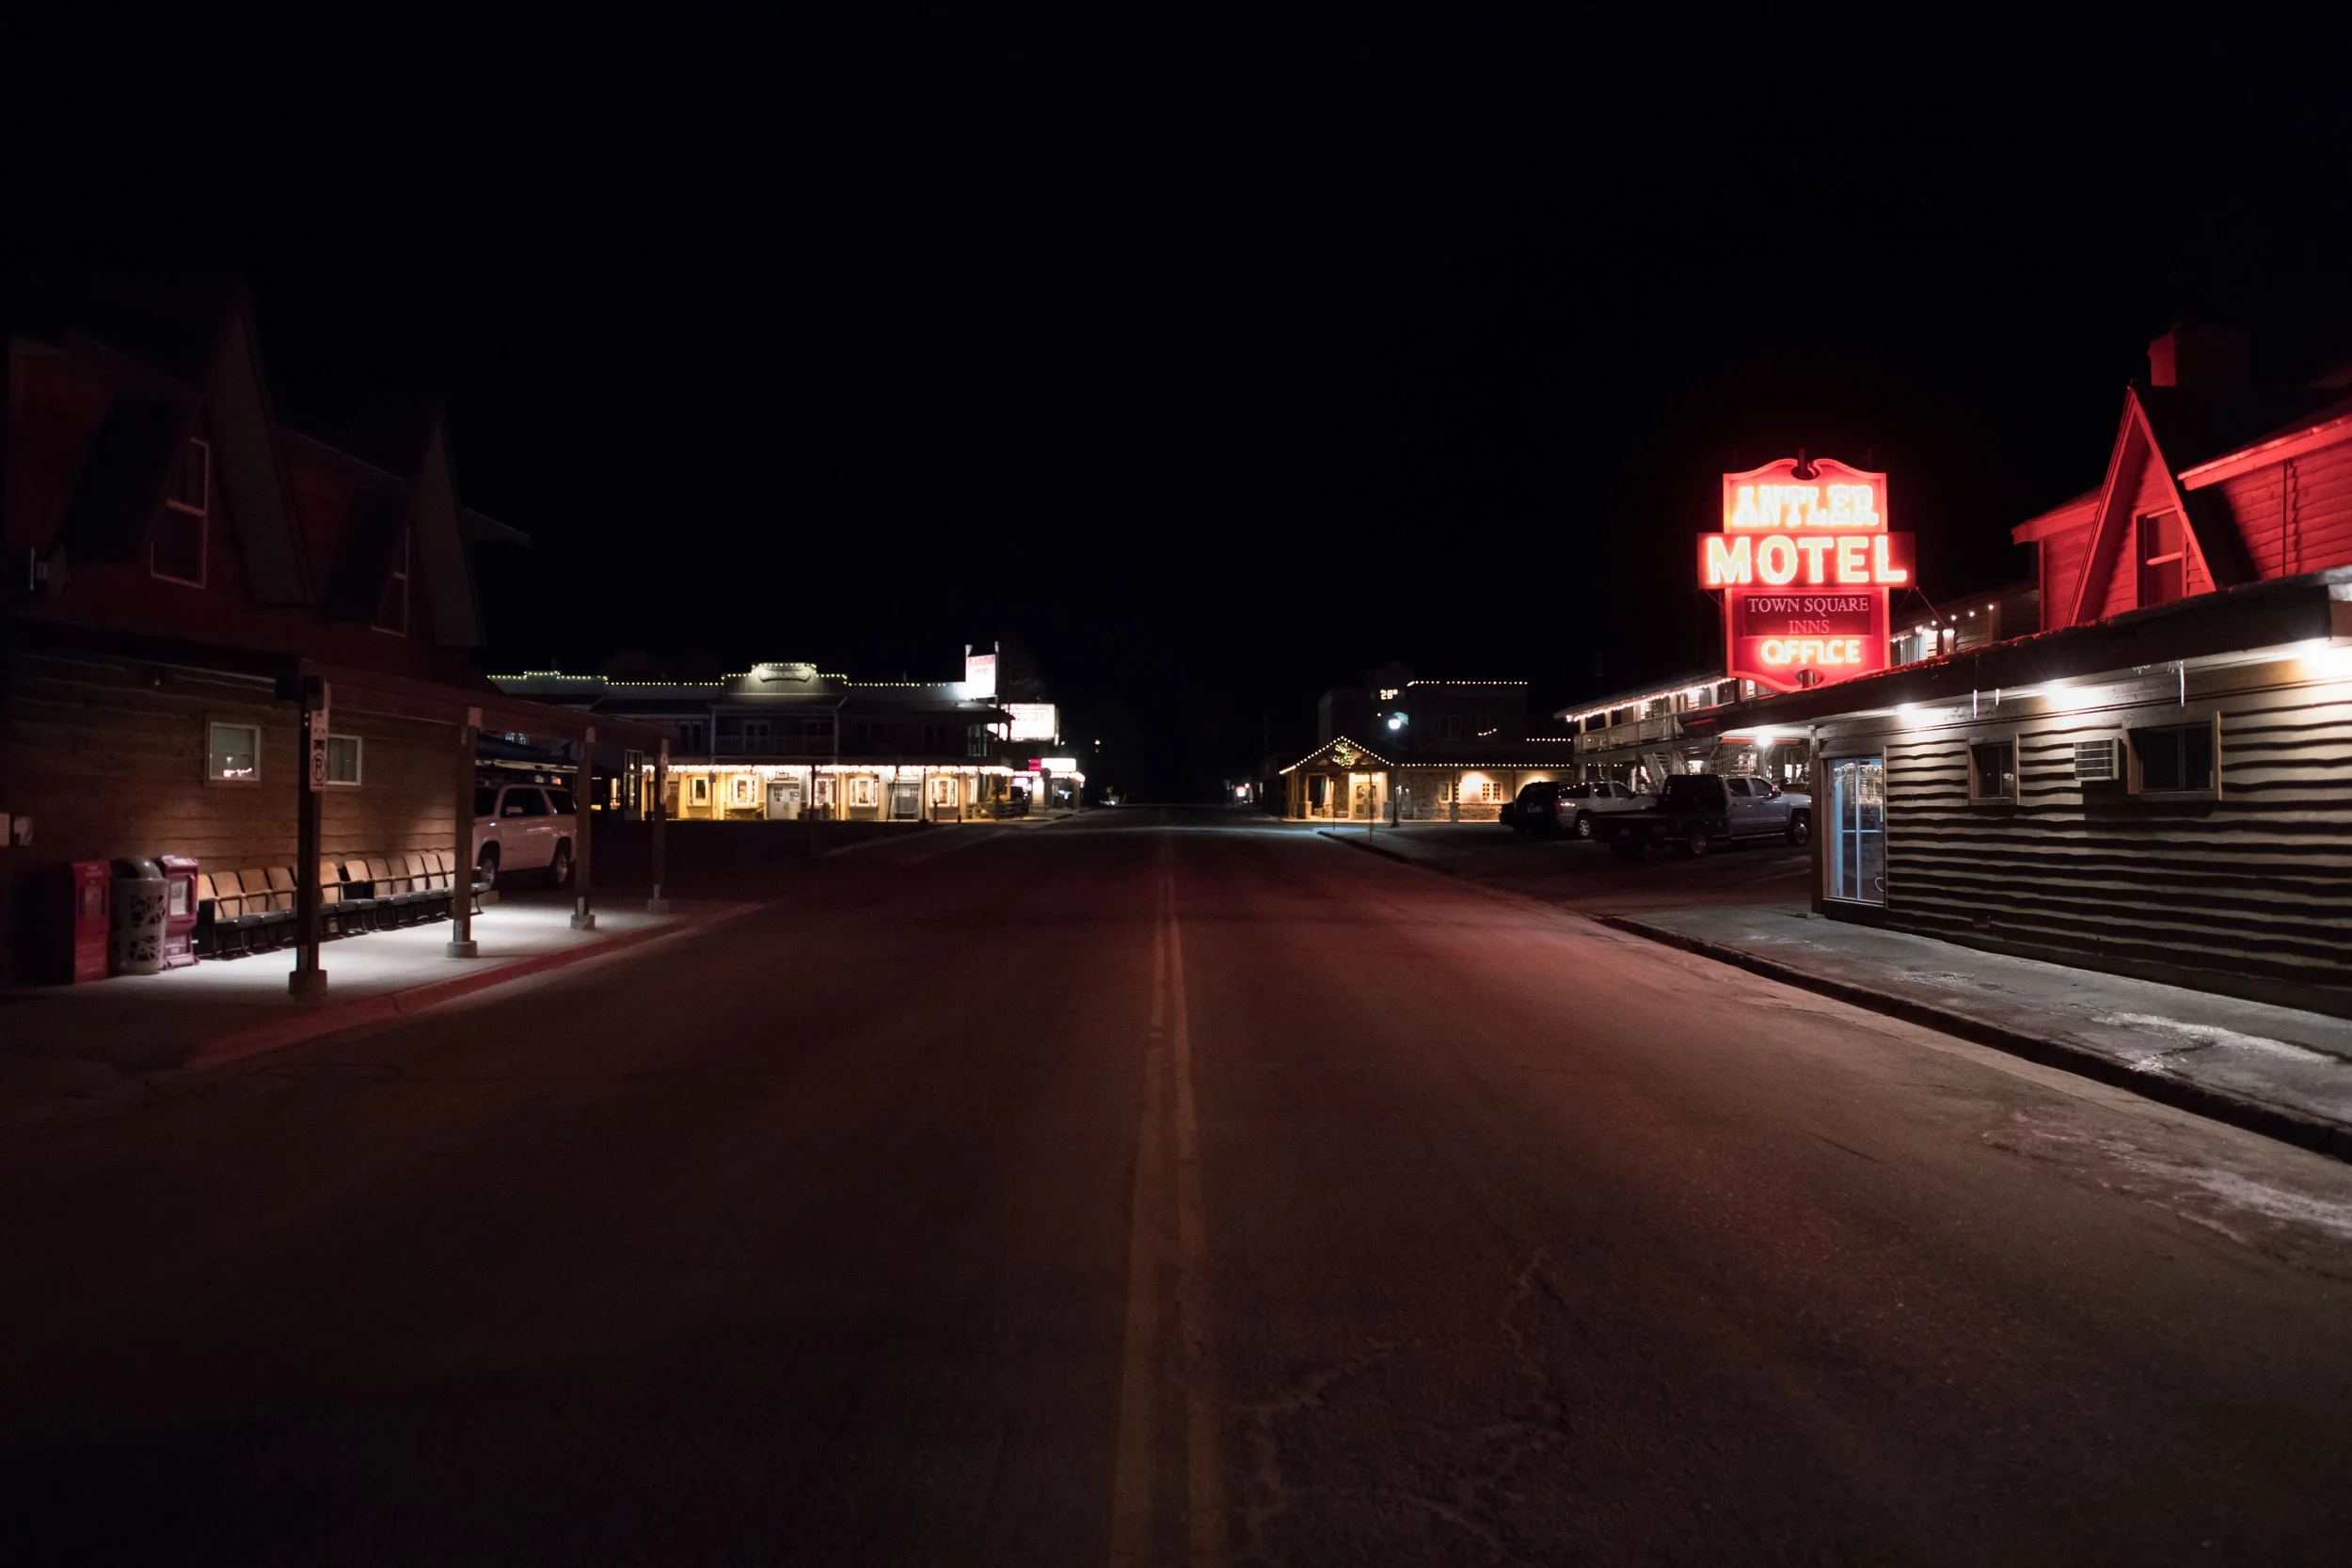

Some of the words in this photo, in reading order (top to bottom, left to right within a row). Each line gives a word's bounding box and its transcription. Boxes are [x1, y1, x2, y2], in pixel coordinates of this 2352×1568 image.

[1731, 483, 1880, 528] ANTLER
[1708, 535, 1908, 585] MOTEL
[1747, 597, 1800, 612] TOWN
[1804, 597, 1869, 616] SQUARE
[1788, 620, 1830, 634] INNS
[1760, 640, 1862, 664] OFFICE
